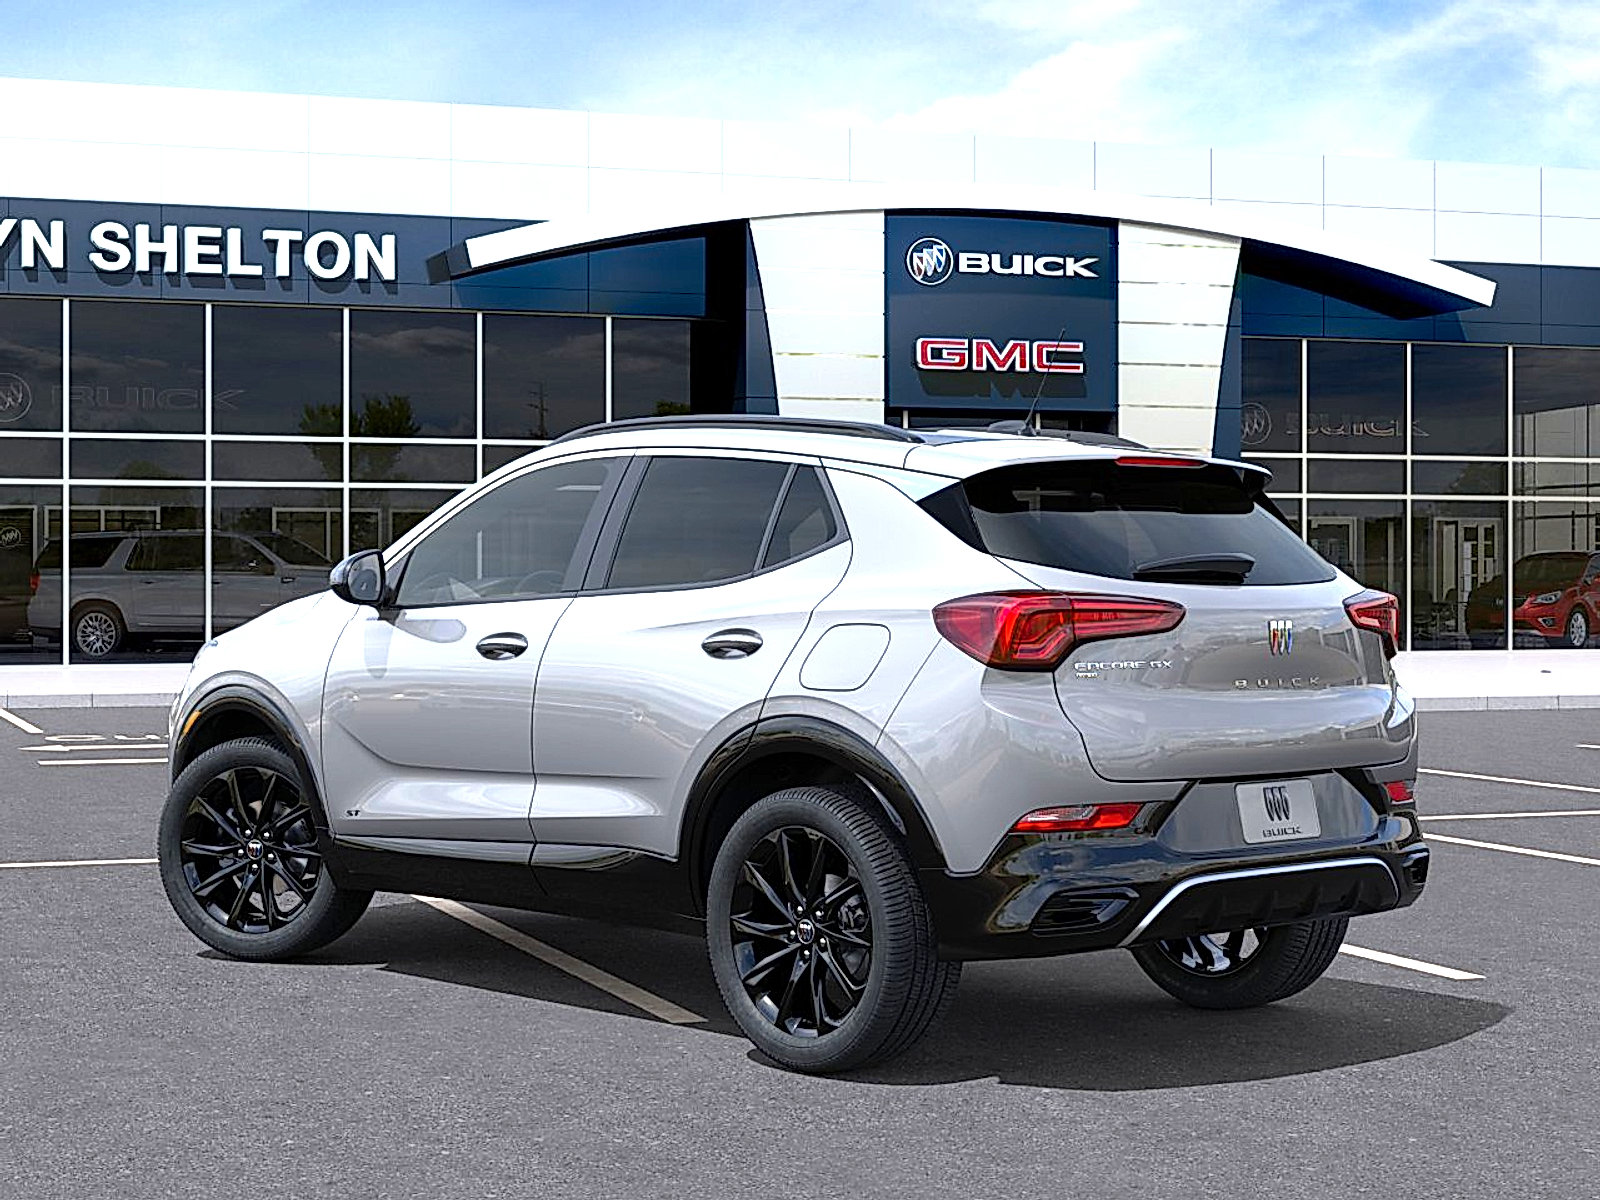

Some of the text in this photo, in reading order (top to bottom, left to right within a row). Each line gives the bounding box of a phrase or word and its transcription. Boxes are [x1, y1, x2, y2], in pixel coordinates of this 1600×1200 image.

[88, 221, 396, 280] SHELTON
[958, 252, 1100, 278] BUICK
[916, 338, 1084, 374] GMC
[1074, 660, 1172, 670] ENCORE GX
[1234, 676, 1320, 690] BUICK
[1262, 827, 1302, 838] BUICK
